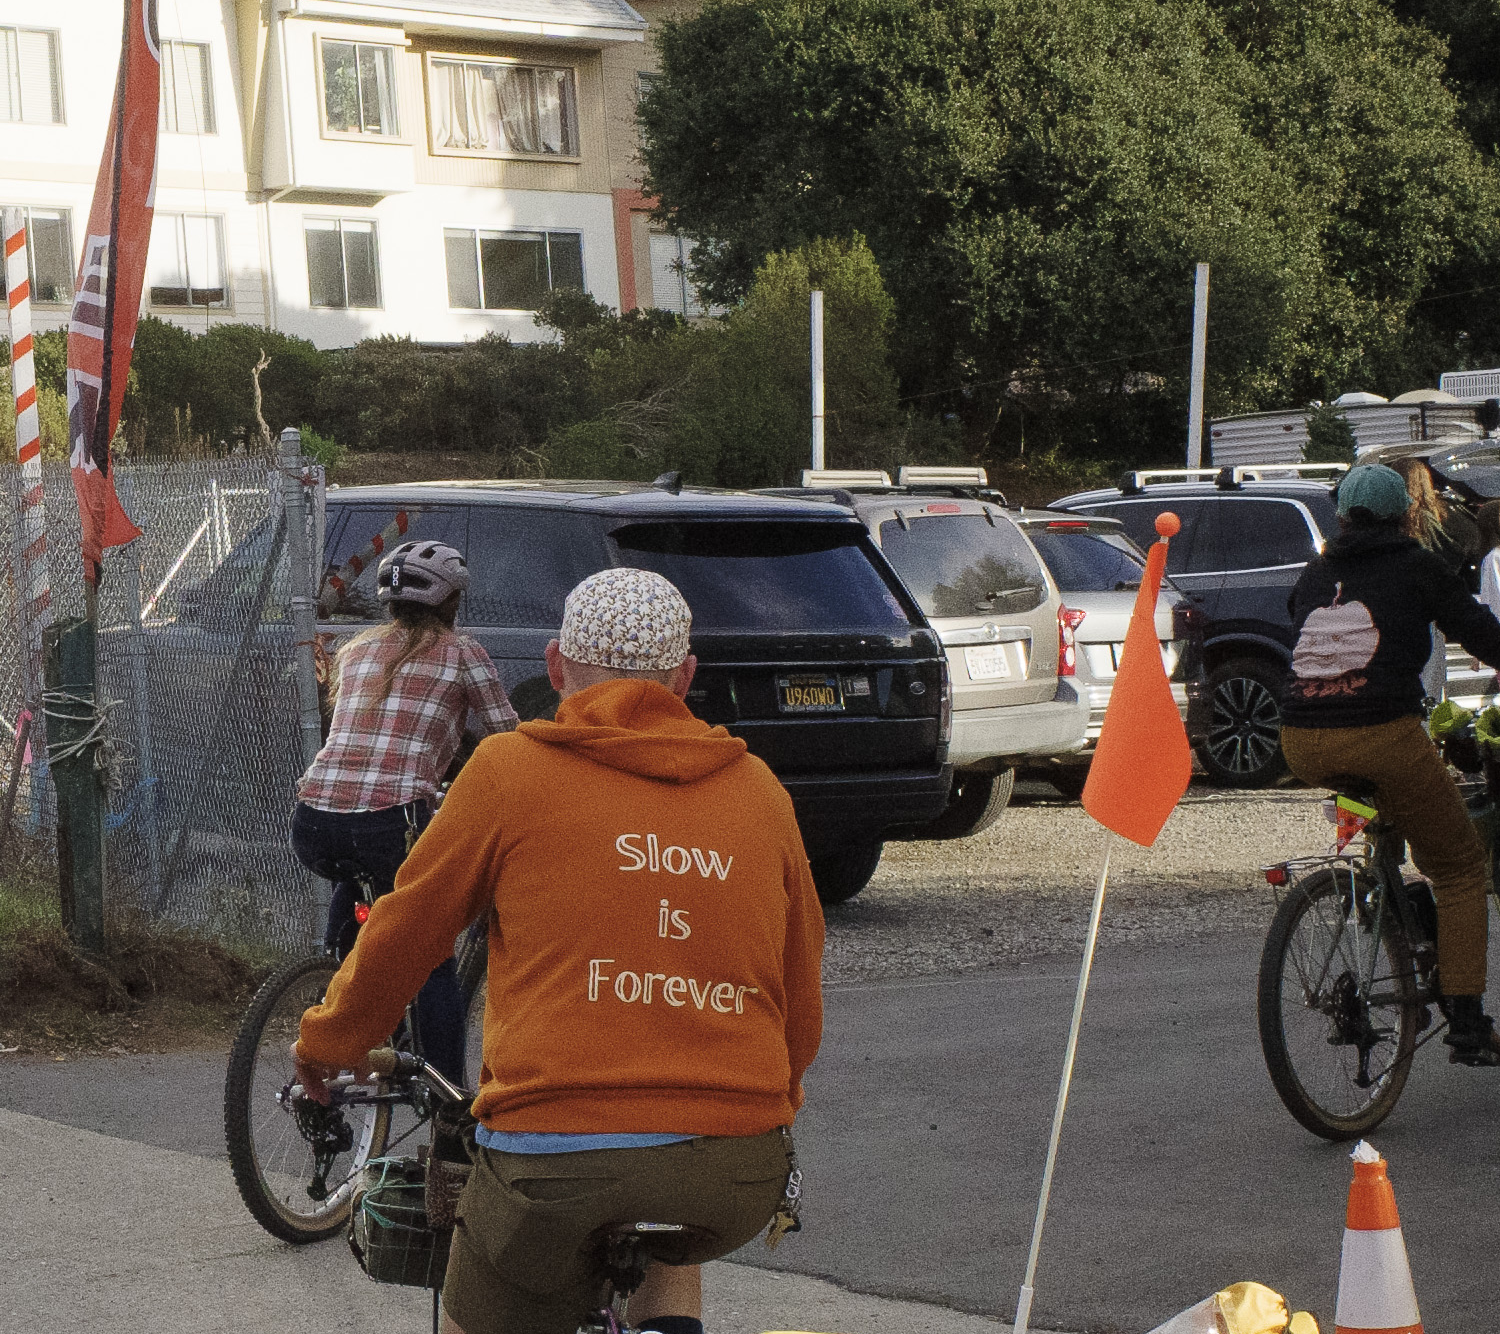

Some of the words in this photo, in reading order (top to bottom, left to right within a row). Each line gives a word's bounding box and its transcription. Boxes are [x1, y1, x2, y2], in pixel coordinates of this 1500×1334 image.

[615, 833, 734, 881] Slow
[658, 898, 692, 940] is
[588, 958, 759, 1014] Forever
